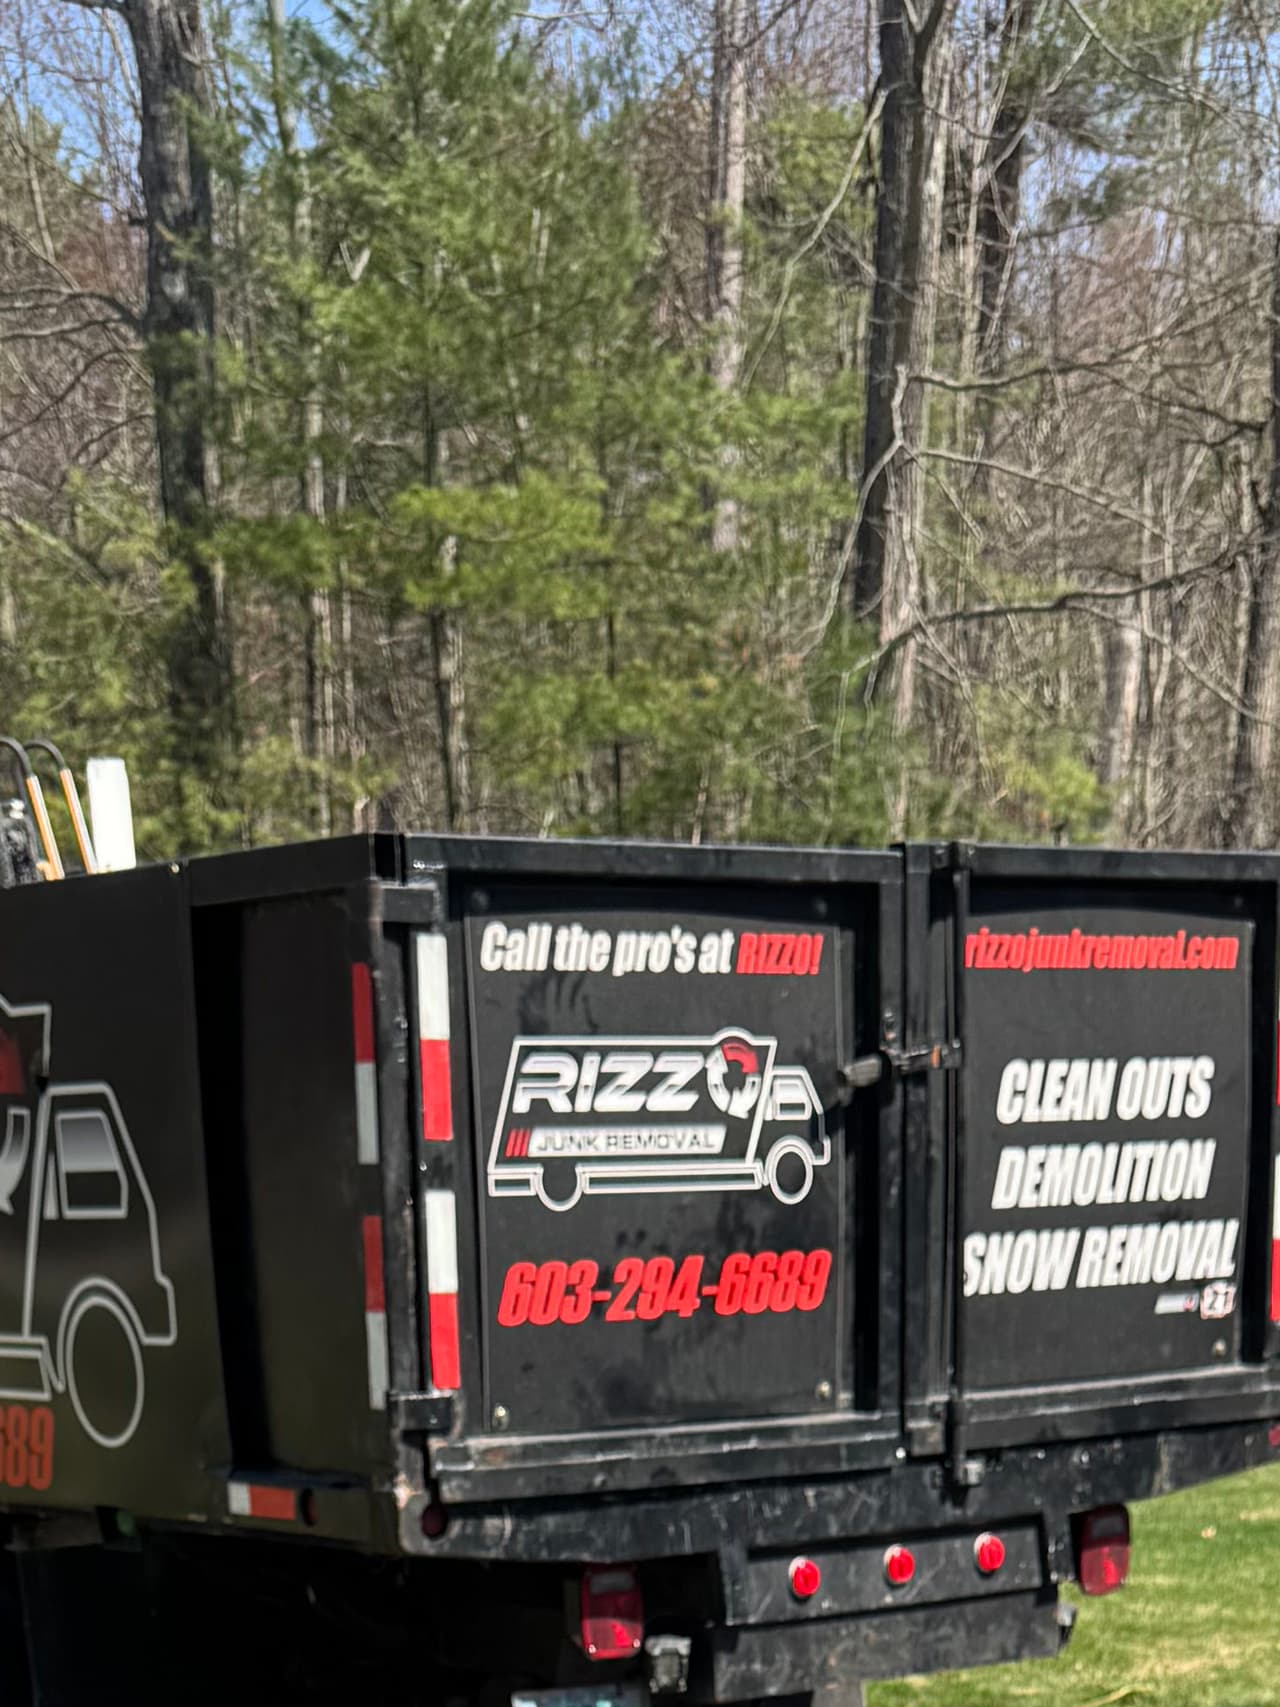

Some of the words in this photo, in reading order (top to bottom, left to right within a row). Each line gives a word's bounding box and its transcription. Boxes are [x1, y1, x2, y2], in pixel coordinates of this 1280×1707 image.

[480, 920, 552, 972] Call
[553, 922, 611, 972] the
[612, 924, 698, 977] pro's
[698, 928, 735, 974] at
[735, 931, 824, 976] RIZZO!
[963, 927, 1239, 973] rizzojunkremoval.com
[996, 1057, 1118, 1125] CLEAN
[1116, 1055, 1216, 1120] OUTS
[537, 1133, 600, 1152] JUNK
[606, 1131, 716, 1151] REMOVAL
[991, 1138, 1217, 1209] DEMOLITION
[497, 1248, 833, 1327] 603-294-6689
[963, 1226, 1081, 1297] SNOW
[1075, 1217, 1240, 1288] REMOVAL
